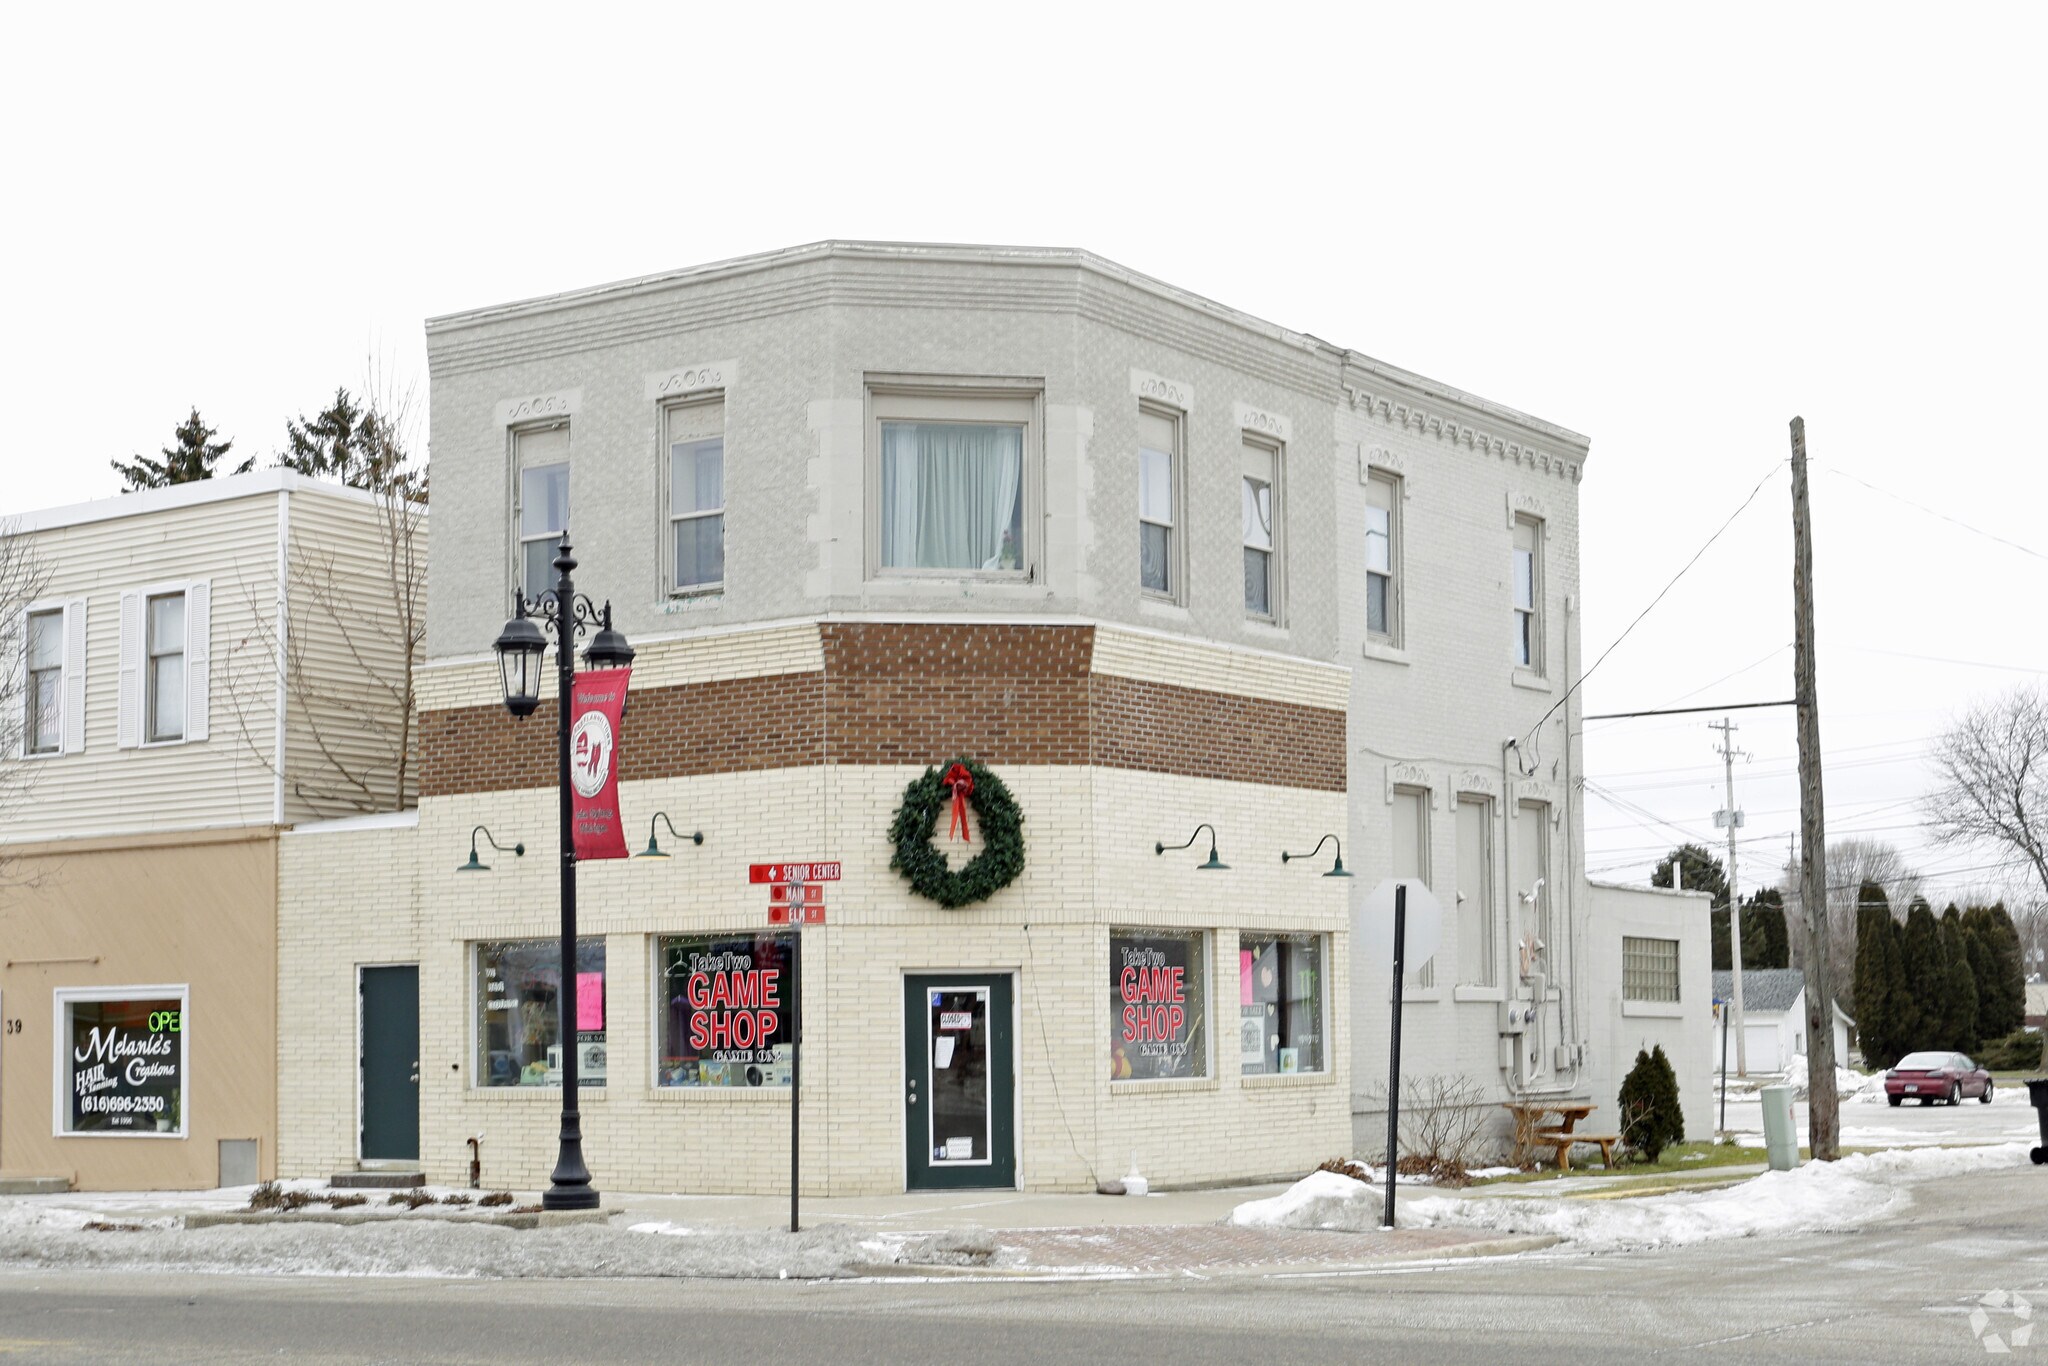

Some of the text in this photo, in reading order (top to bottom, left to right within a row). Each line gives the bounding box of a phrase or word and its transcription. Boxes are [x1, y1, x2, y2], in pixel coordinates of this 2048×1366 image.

[783, 863, 840, 881] SENIOR CENTER
[786, 886, 805, 902] MAIN
[789, 907, 805, 922] ELM
[688, 969, 780, 1009] GAME
[1120, 966, 1185, 1004] GAME
[7, 1019, 22, 1034] 39
[148, 1011, 181, 1033] OPE
[690, 1010, 778, 1050] SHOP
[1122, 1005, 1184, 1043] SHOP
[75, 1026, 171, 1064] Melanie's
[713, 1050, 753, 1063] GAME
[76, 1063, 105, 1092] HAIR
[125, 1057, 175, 1086] Creations
[87, 1076, 118, 1093] Tanning
[81, 1096, 164, 1114] (616)696-2350
